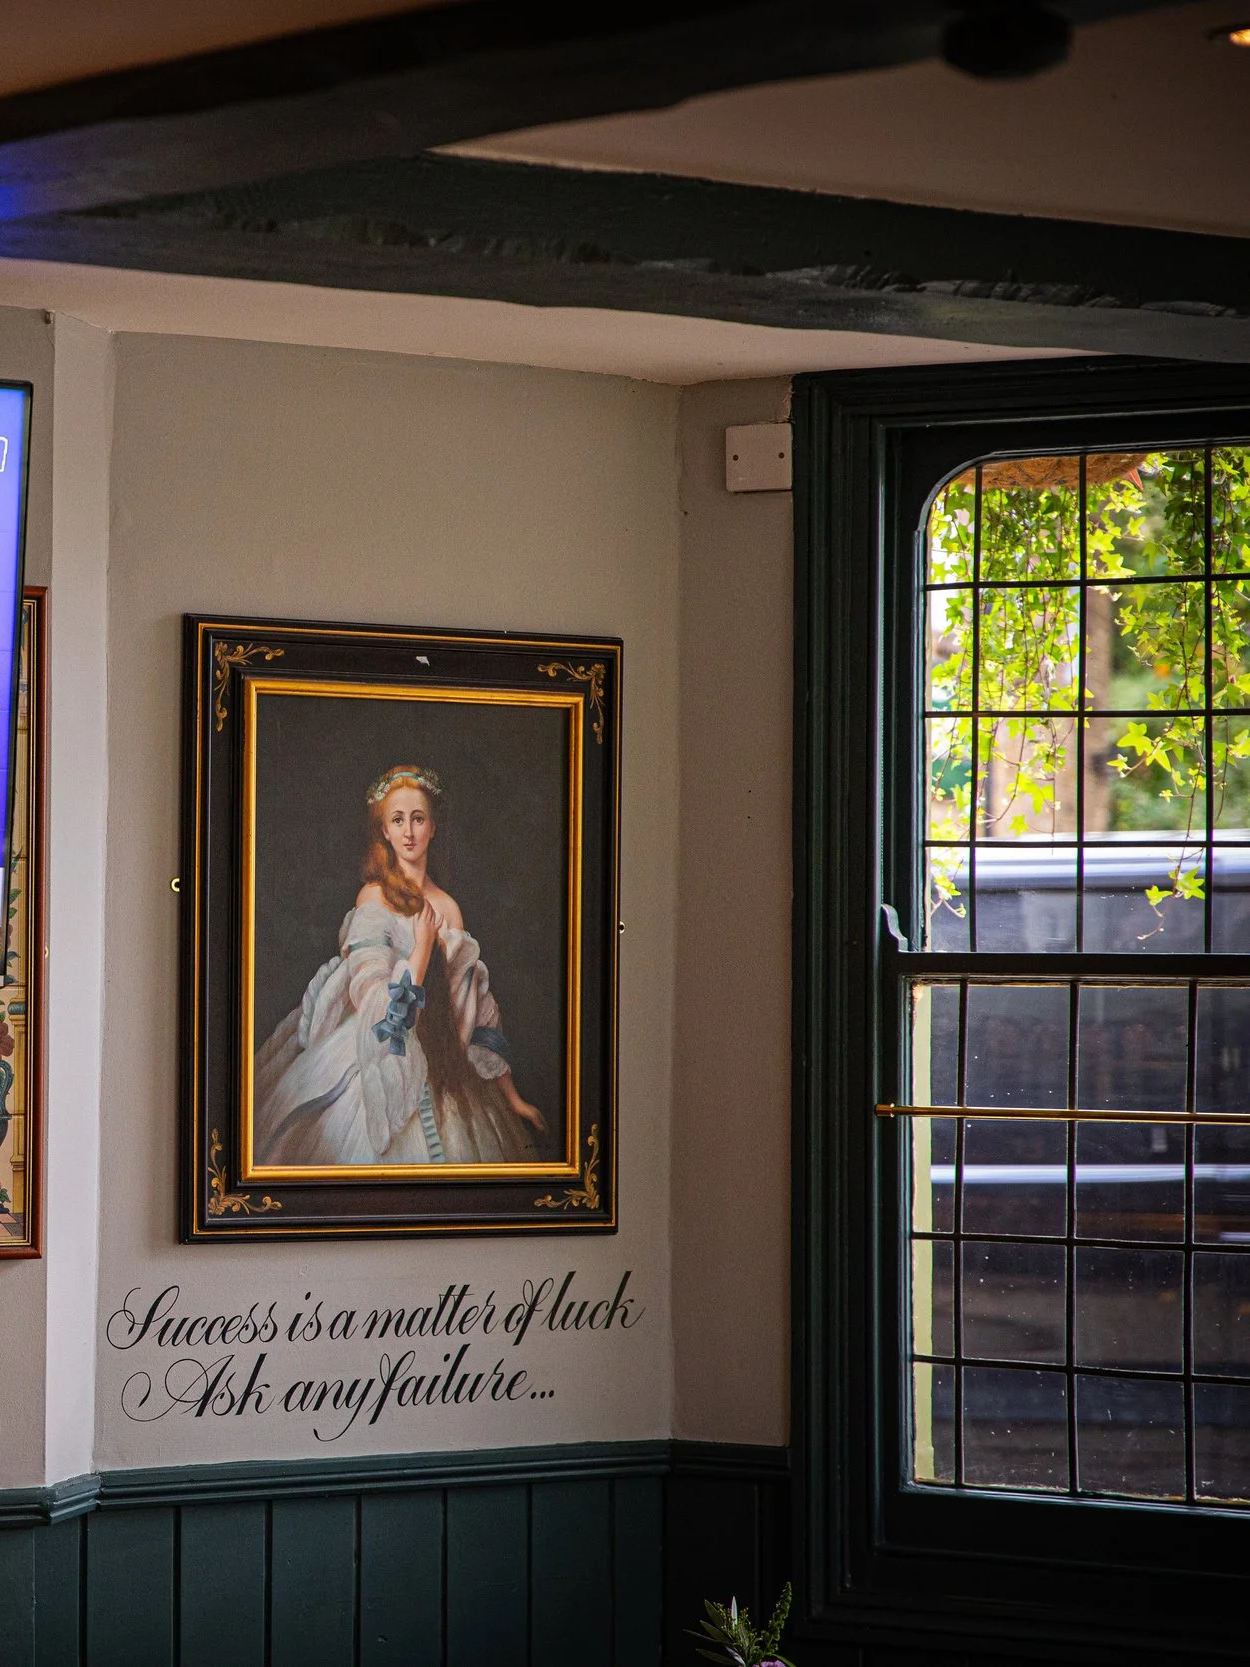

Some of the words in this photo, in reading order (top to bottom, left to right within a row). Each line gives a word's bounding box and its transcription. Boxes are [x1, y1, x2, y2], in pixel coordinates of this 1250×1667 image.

[106, 1285, 277, 1350] Success
[288, 1291, 323, 1342] is
[328, 1311, 357, 1339] a
[363, 1283, 499, 1339] matter
[503, 1277, 556, 1346] of
[549, 1270, 646, 1332] luck
[121, 1353, 276, 1422] Ask
[283, 1374, 374, 1442] any
[367, 1343, 556, 1425] failure...
